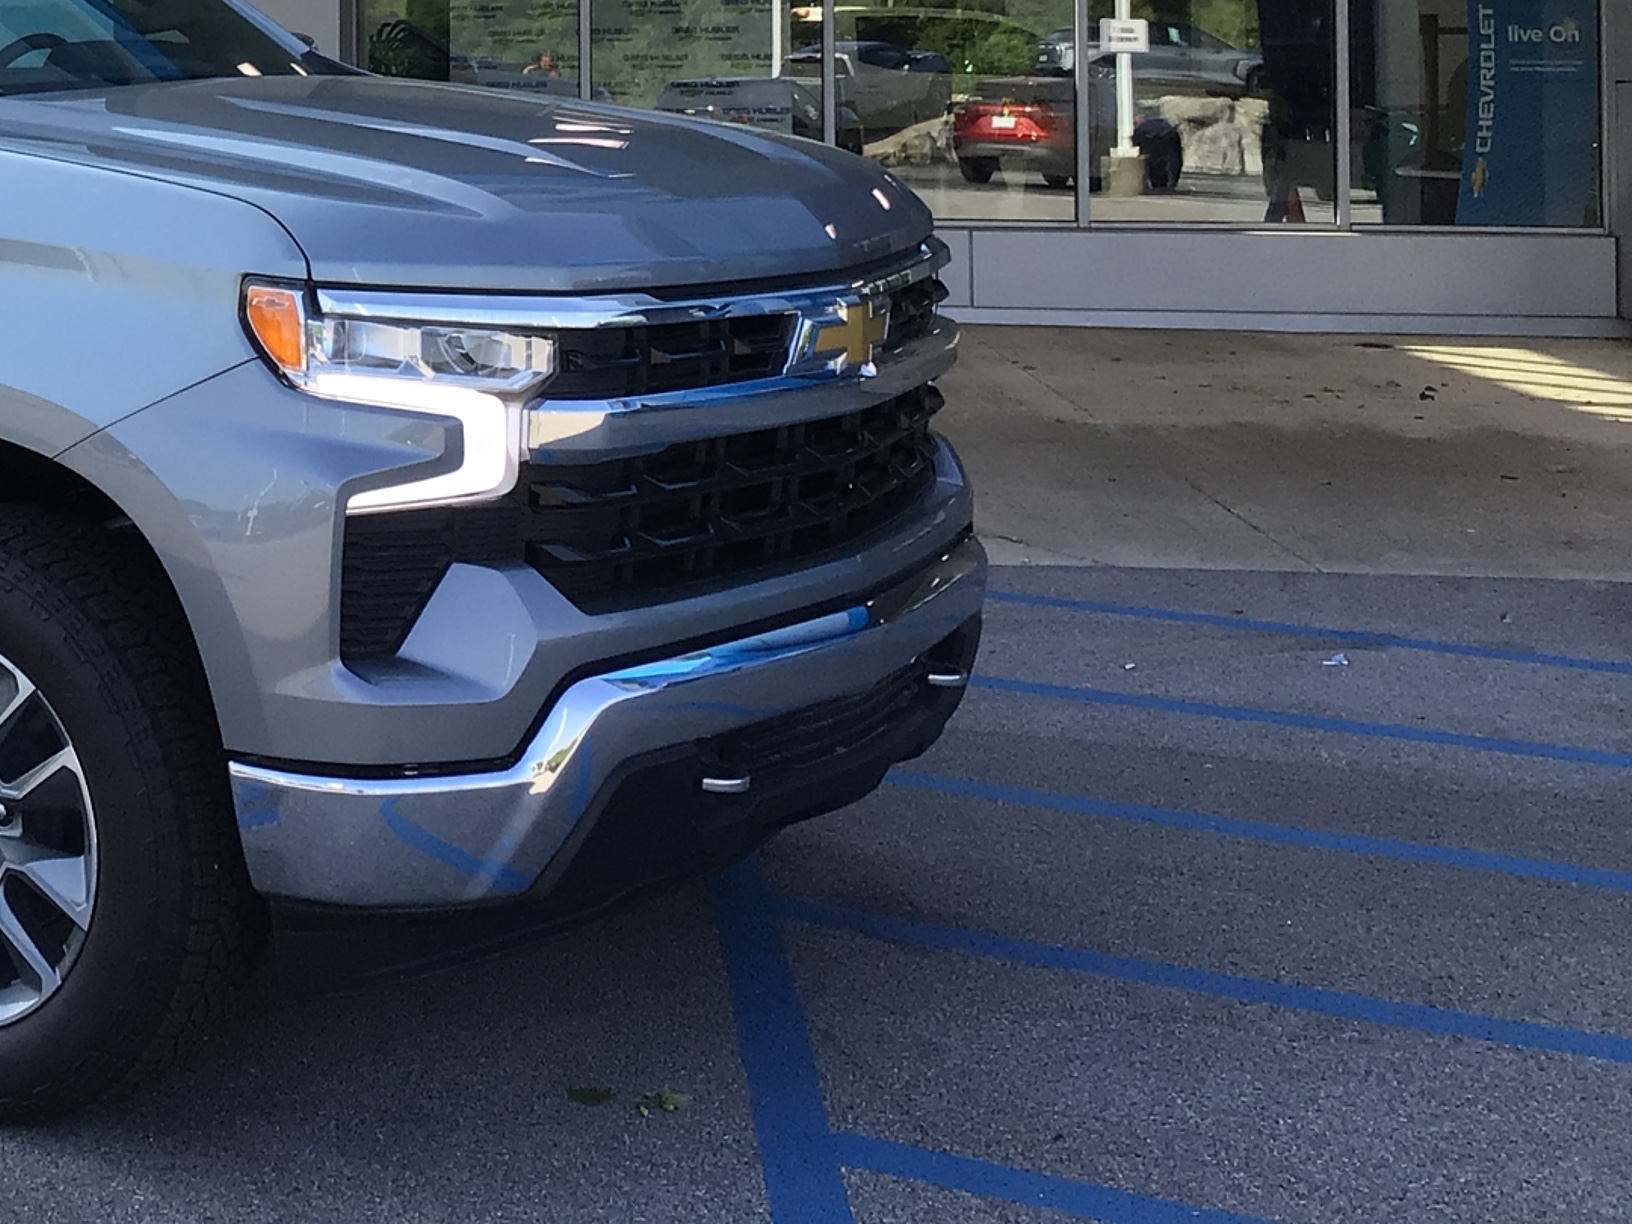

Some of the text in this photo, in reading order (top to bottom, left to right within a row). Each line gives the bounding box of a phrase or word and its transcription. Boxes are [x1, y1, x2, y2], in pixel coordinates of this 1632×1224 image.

[1508, 25, 1580, 43] live On
[1475, 3, 1496, 154] CHEVROLET
